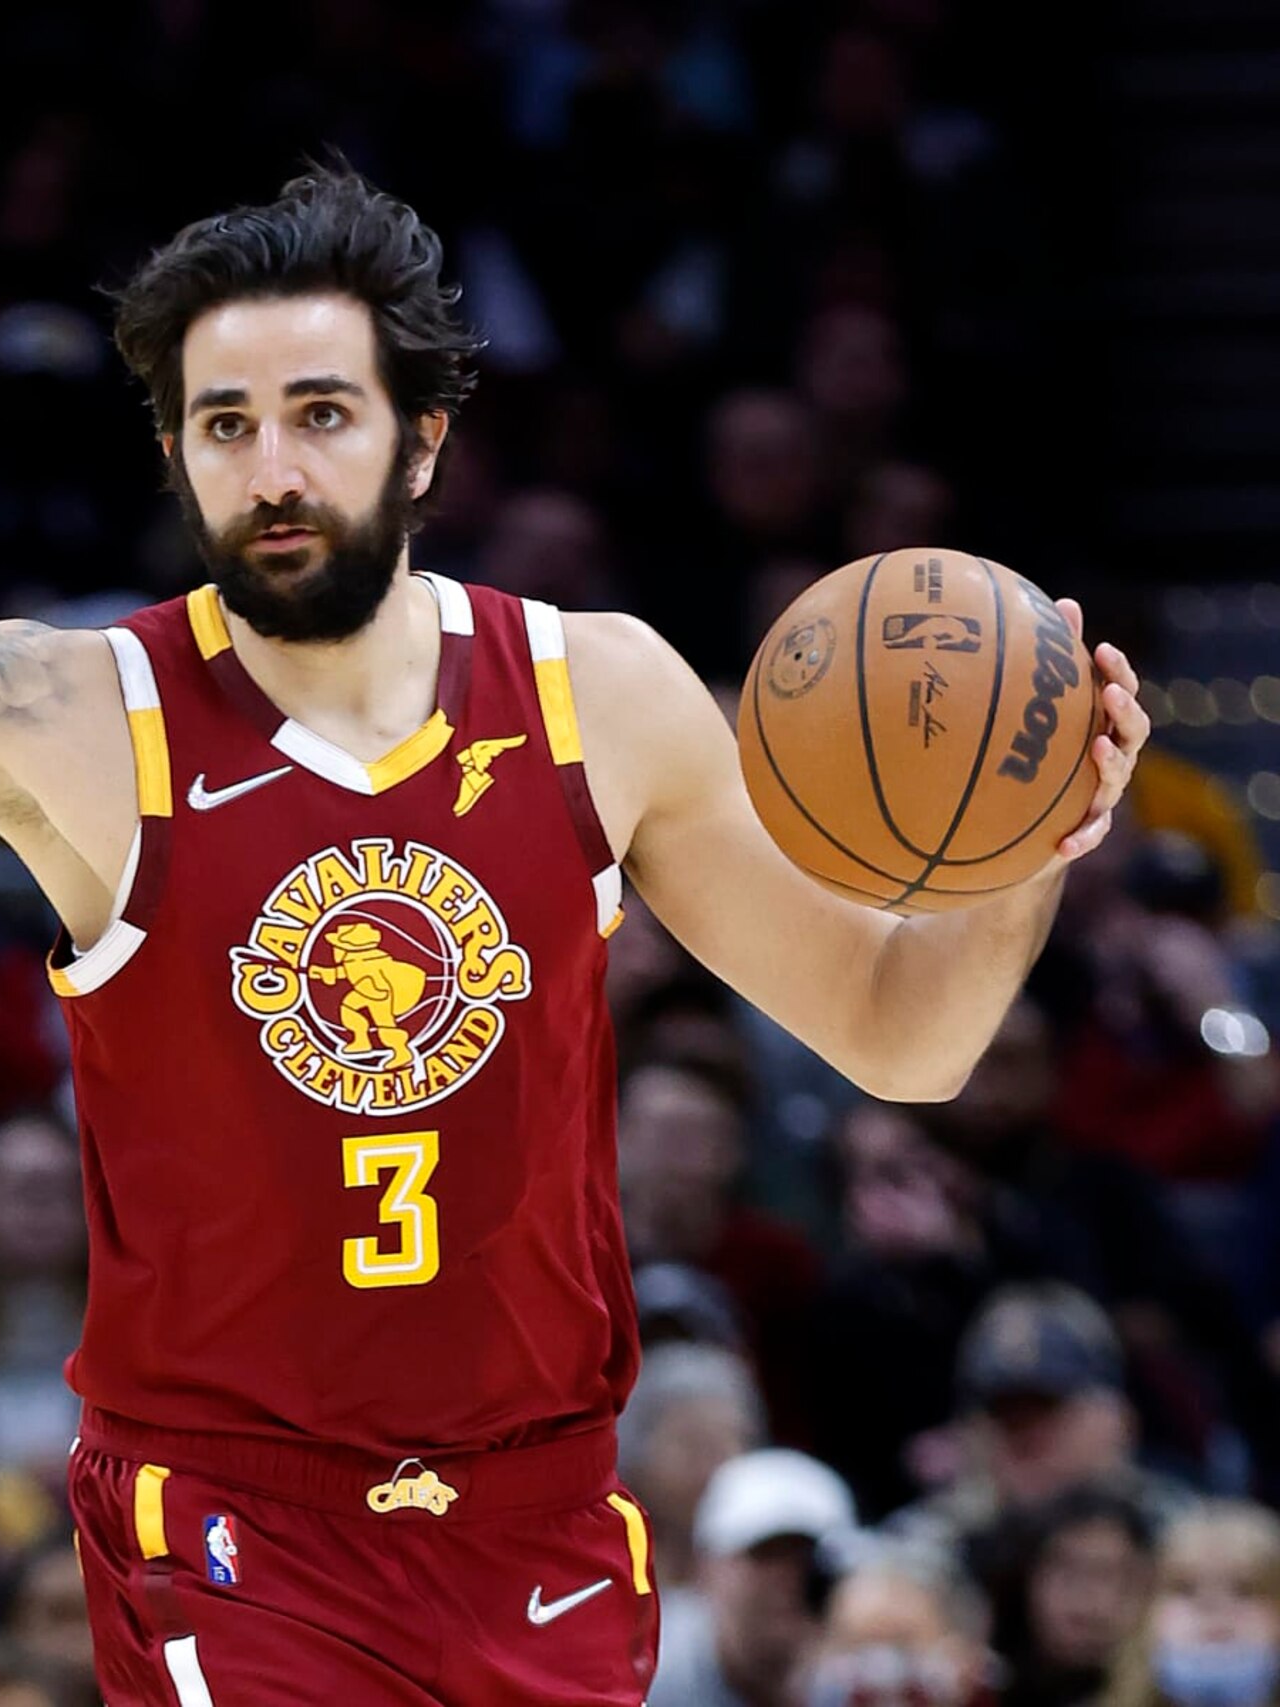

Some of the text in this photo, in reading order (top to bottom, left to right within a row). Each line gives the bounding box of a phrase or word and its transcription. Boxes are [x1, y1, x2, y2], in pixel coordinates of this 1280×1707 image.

[230, 838, 531, 1019] CAVALIERS
[261, 1003, 504, 1115] CLEVELAND
[342, 1130, 440, 1289] 3
